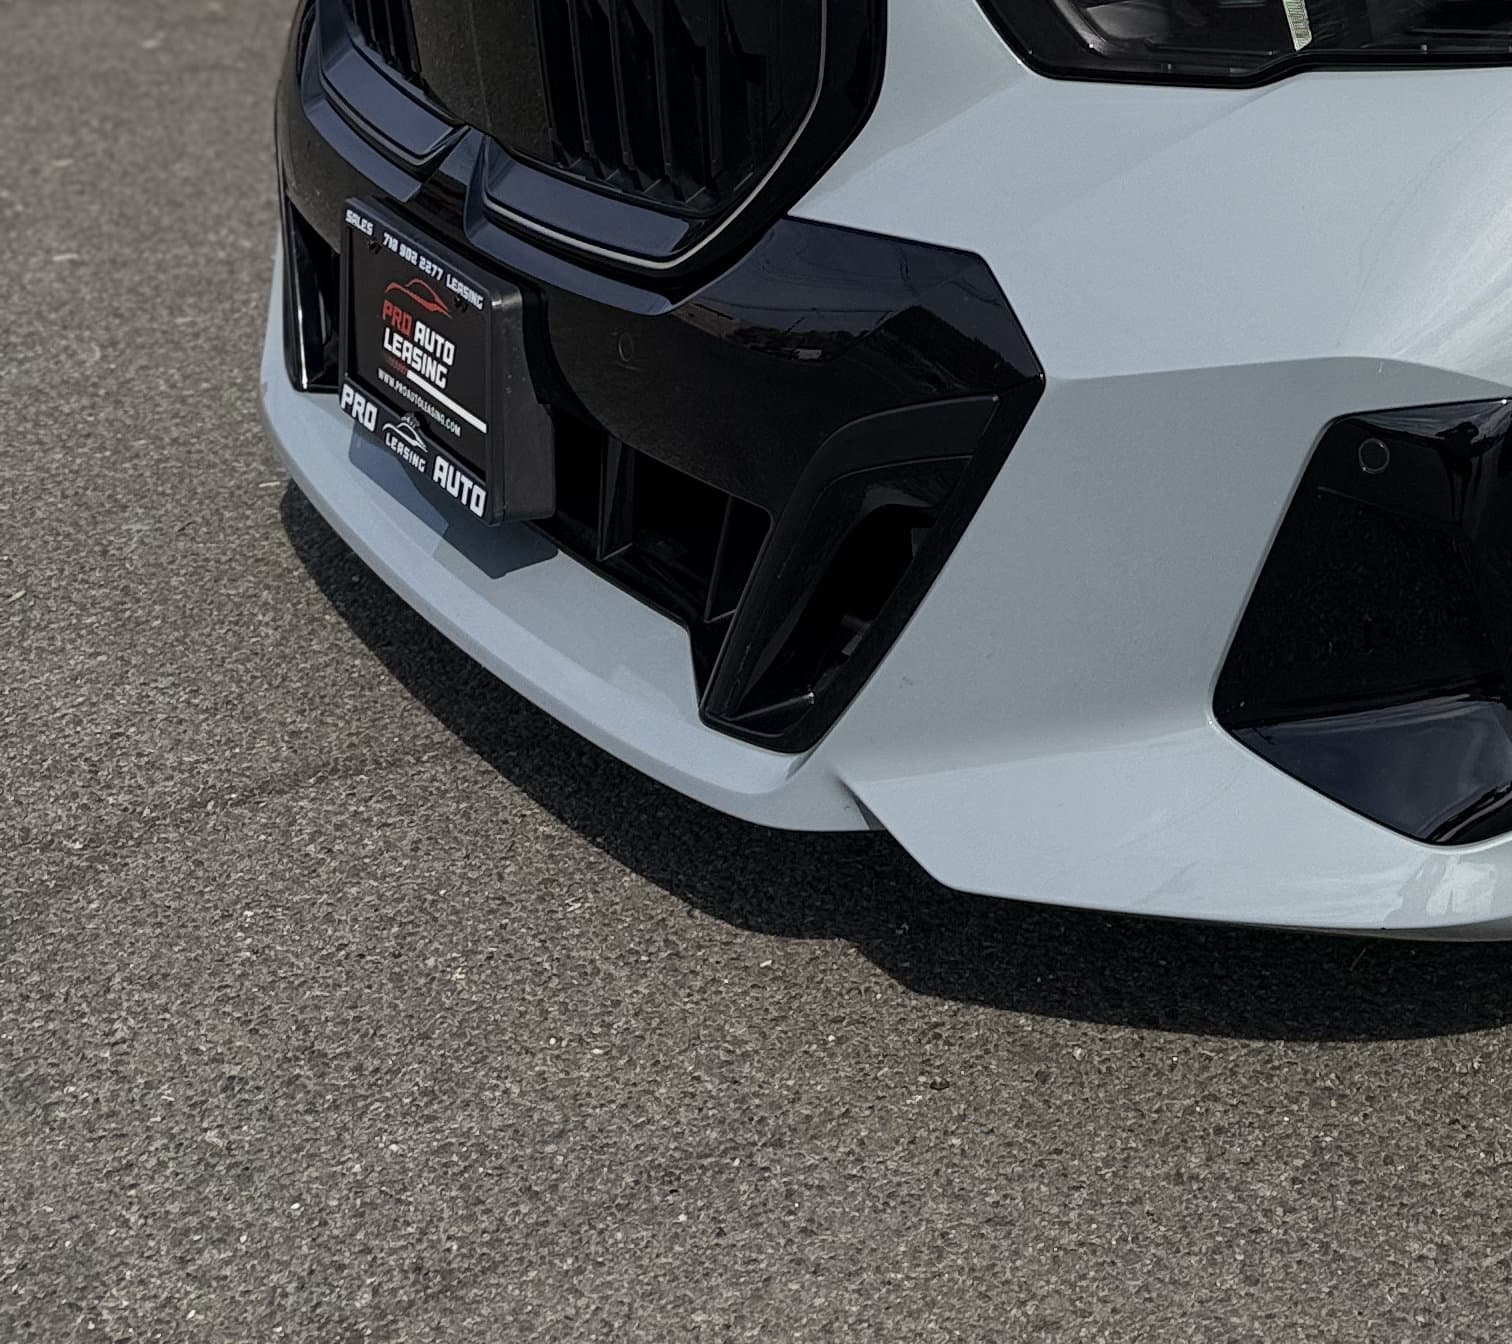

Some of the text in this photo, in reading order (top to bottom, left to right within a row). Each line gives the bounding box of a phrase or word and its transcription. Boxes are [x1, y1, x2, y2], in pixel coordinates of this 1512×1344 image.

[345, 209, 484, 311] SALES 718 902 2277 LEASING
[382, 299, 413, 337] PRO
[414, 320, 456, 366] AUTO
[383, 327, 449, 390] LEASING
[340, 383, 488, 519] PRO LEASING AUTO
